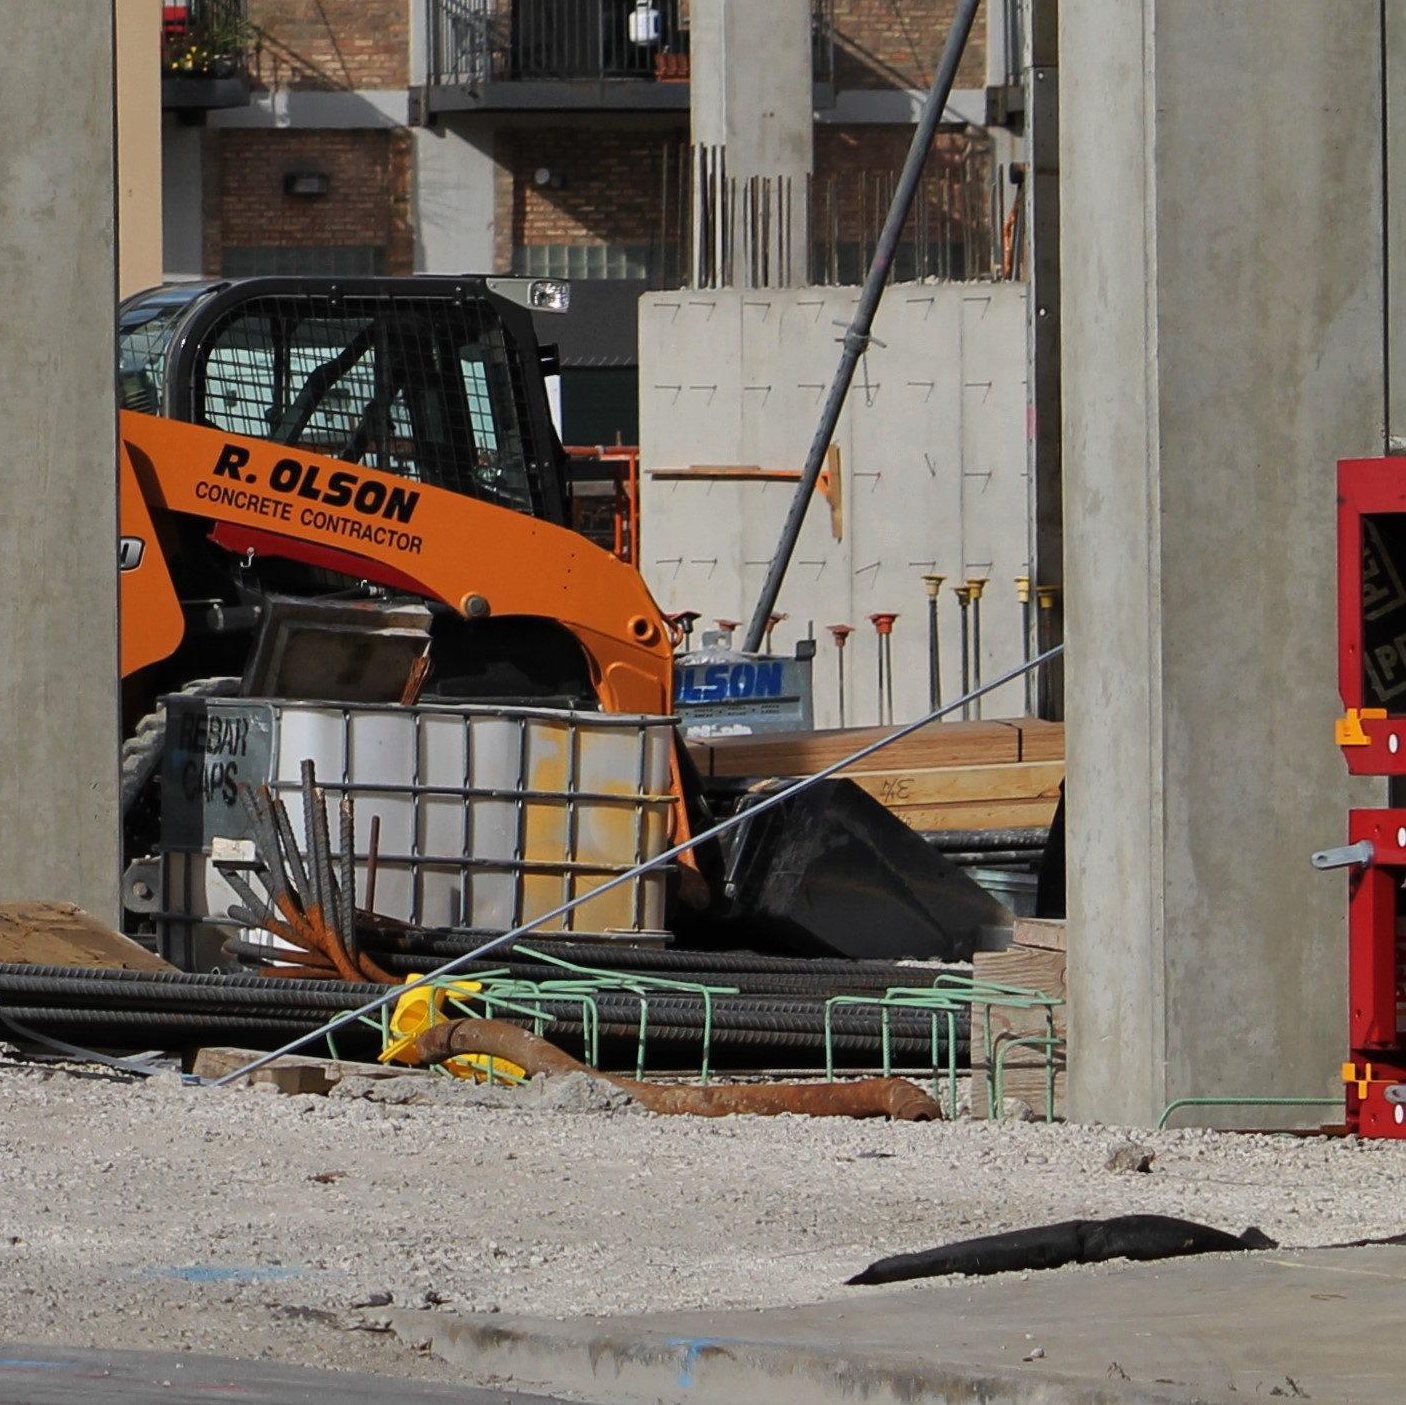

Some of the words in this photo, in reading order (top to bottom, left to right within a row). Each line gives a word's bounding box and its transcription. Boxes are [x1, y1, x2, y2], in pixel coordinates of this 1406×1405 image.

[195, 481, 294, 521] CONCRETE
[300, 508, 423, 554] CONTRACTOR
[212, 443, 258, 484] R.
[269, 458, 421, 524] OLSON
